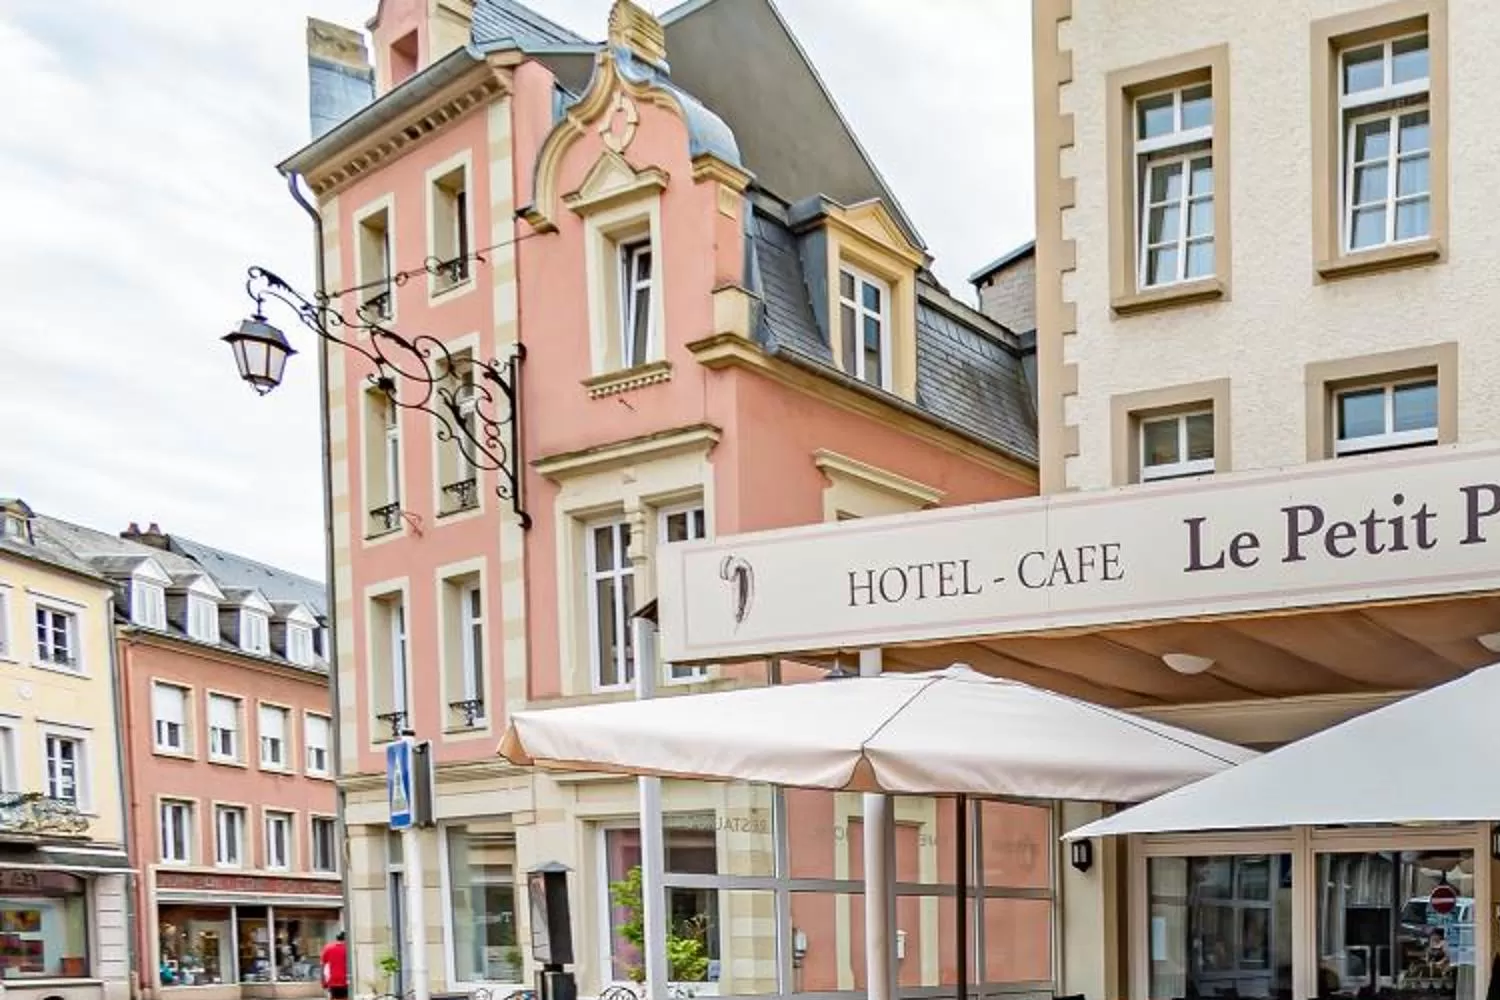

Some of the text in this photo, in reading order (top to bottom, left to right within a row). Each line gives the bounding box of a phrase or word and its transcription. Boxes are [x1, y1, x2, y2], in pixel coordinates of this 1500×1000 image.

[1183, 516, 1260, 572] Le
[1281, 493, 1438, 563] Petit
[847, 560, 982, 606] HOTEL
[1017, 543, 1125, 589] CAFE
